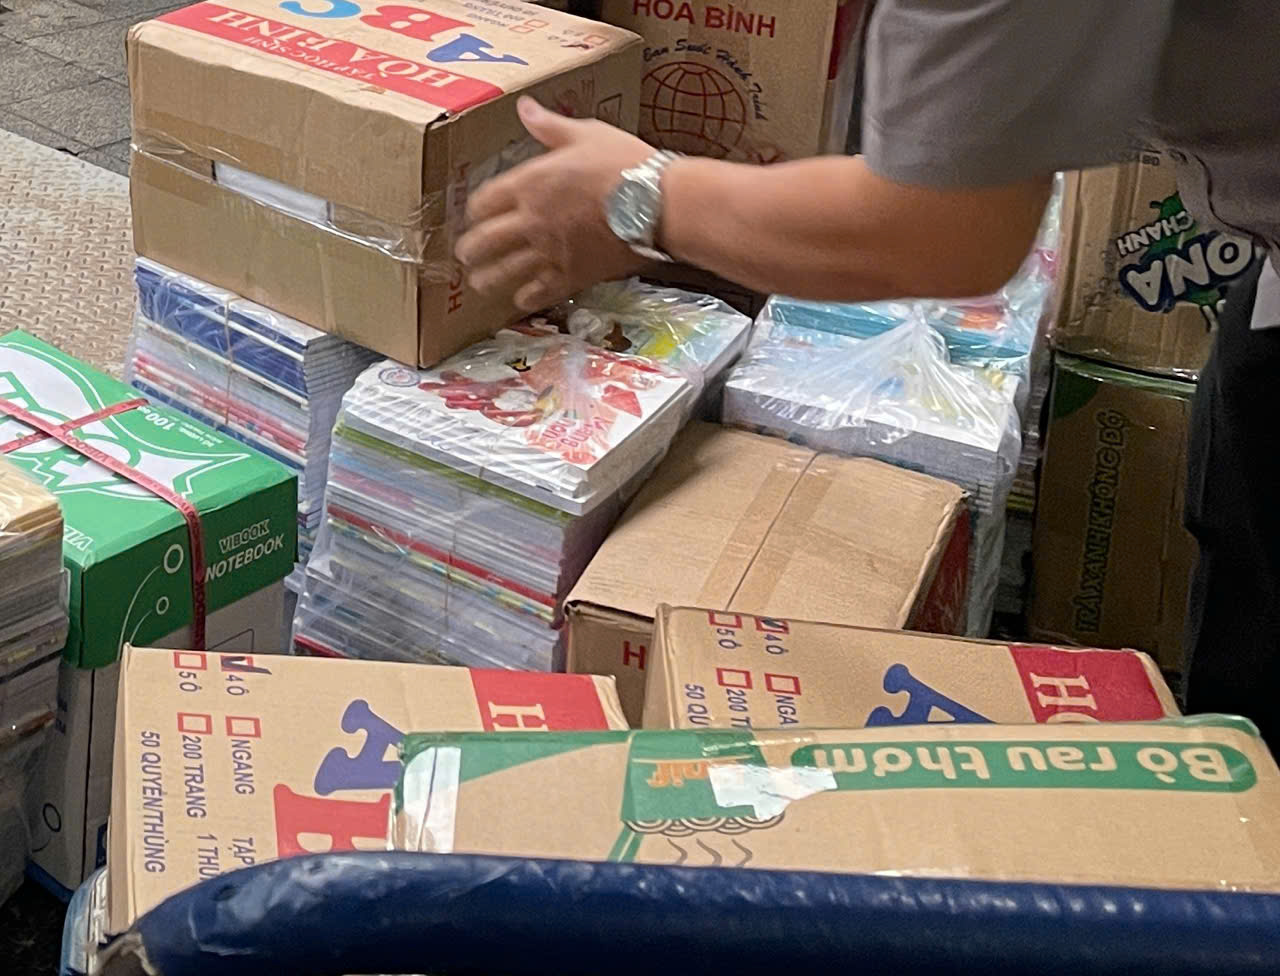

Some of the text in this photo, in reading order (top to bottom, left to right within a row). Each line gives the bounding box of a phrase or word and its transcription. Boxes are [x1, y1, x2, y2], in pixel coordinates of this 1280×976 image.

[704, 3, 777, 39] BÌNH
[206, 9, 459, 88] HÒA BÌNH
[1117, 210, 1195, 259] CHANH
[145, 412, 176, 431] 100
[219, 518, 271, 554] VIBOOK
[204, 533, 285, 584] NOTEBOOK
[716, 628, 736, 637] 5
[764, 633, 783, 642] 4
[178, 671, 202, 692] 5 Ô
[225, 674, 250, 696] 4 Ô
[685, 683, 705, 700] 50
[726, 688, 748, 713] 200
[775, 694, 799, 726] NGA
[141, 730, 162, 748] 50
[181, 734, 207, 819] 200 TRANG
[230, 738, 255, 795] NGANG
[646, 760, 709, 790] nif
[813, 745, 1234, 784] Bò rau thơm
[227, 837, 256, 866] TẬP
